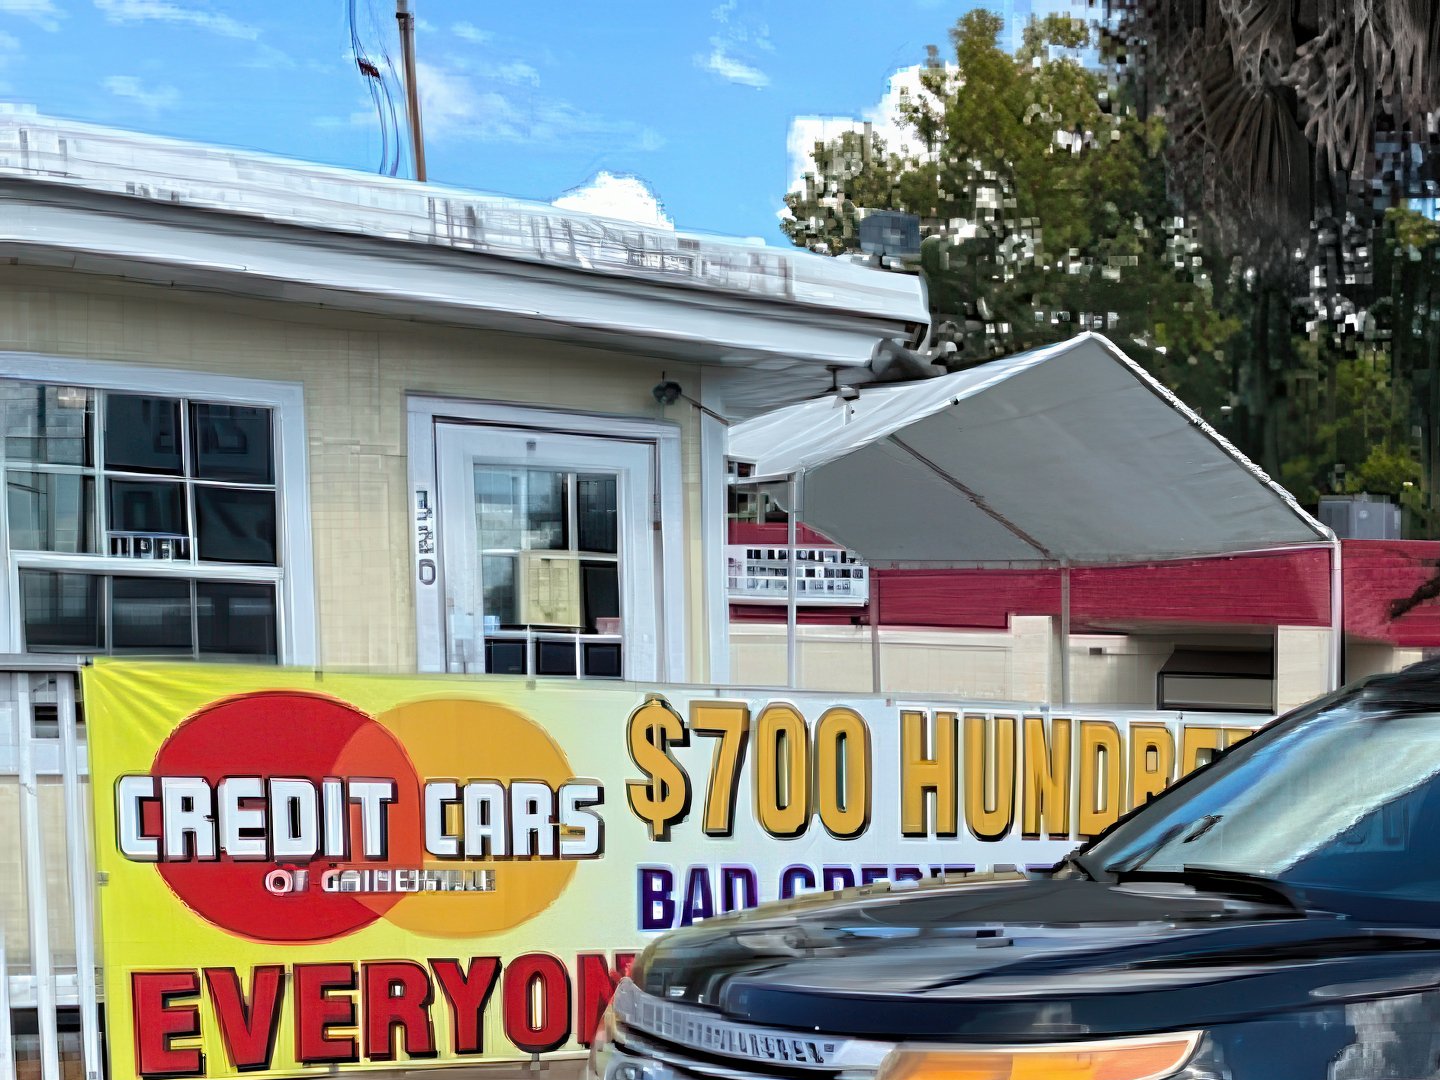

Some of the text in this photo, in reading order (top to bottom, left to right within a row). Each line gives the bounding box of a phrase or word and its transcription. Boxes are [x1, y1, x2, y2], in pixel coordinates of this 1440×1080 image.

[626, 693, 1255, 842] $700 HUNDR
[117, 776, 605, 861] CREDIT CARS
[640, 866, 758, 930] BAD
